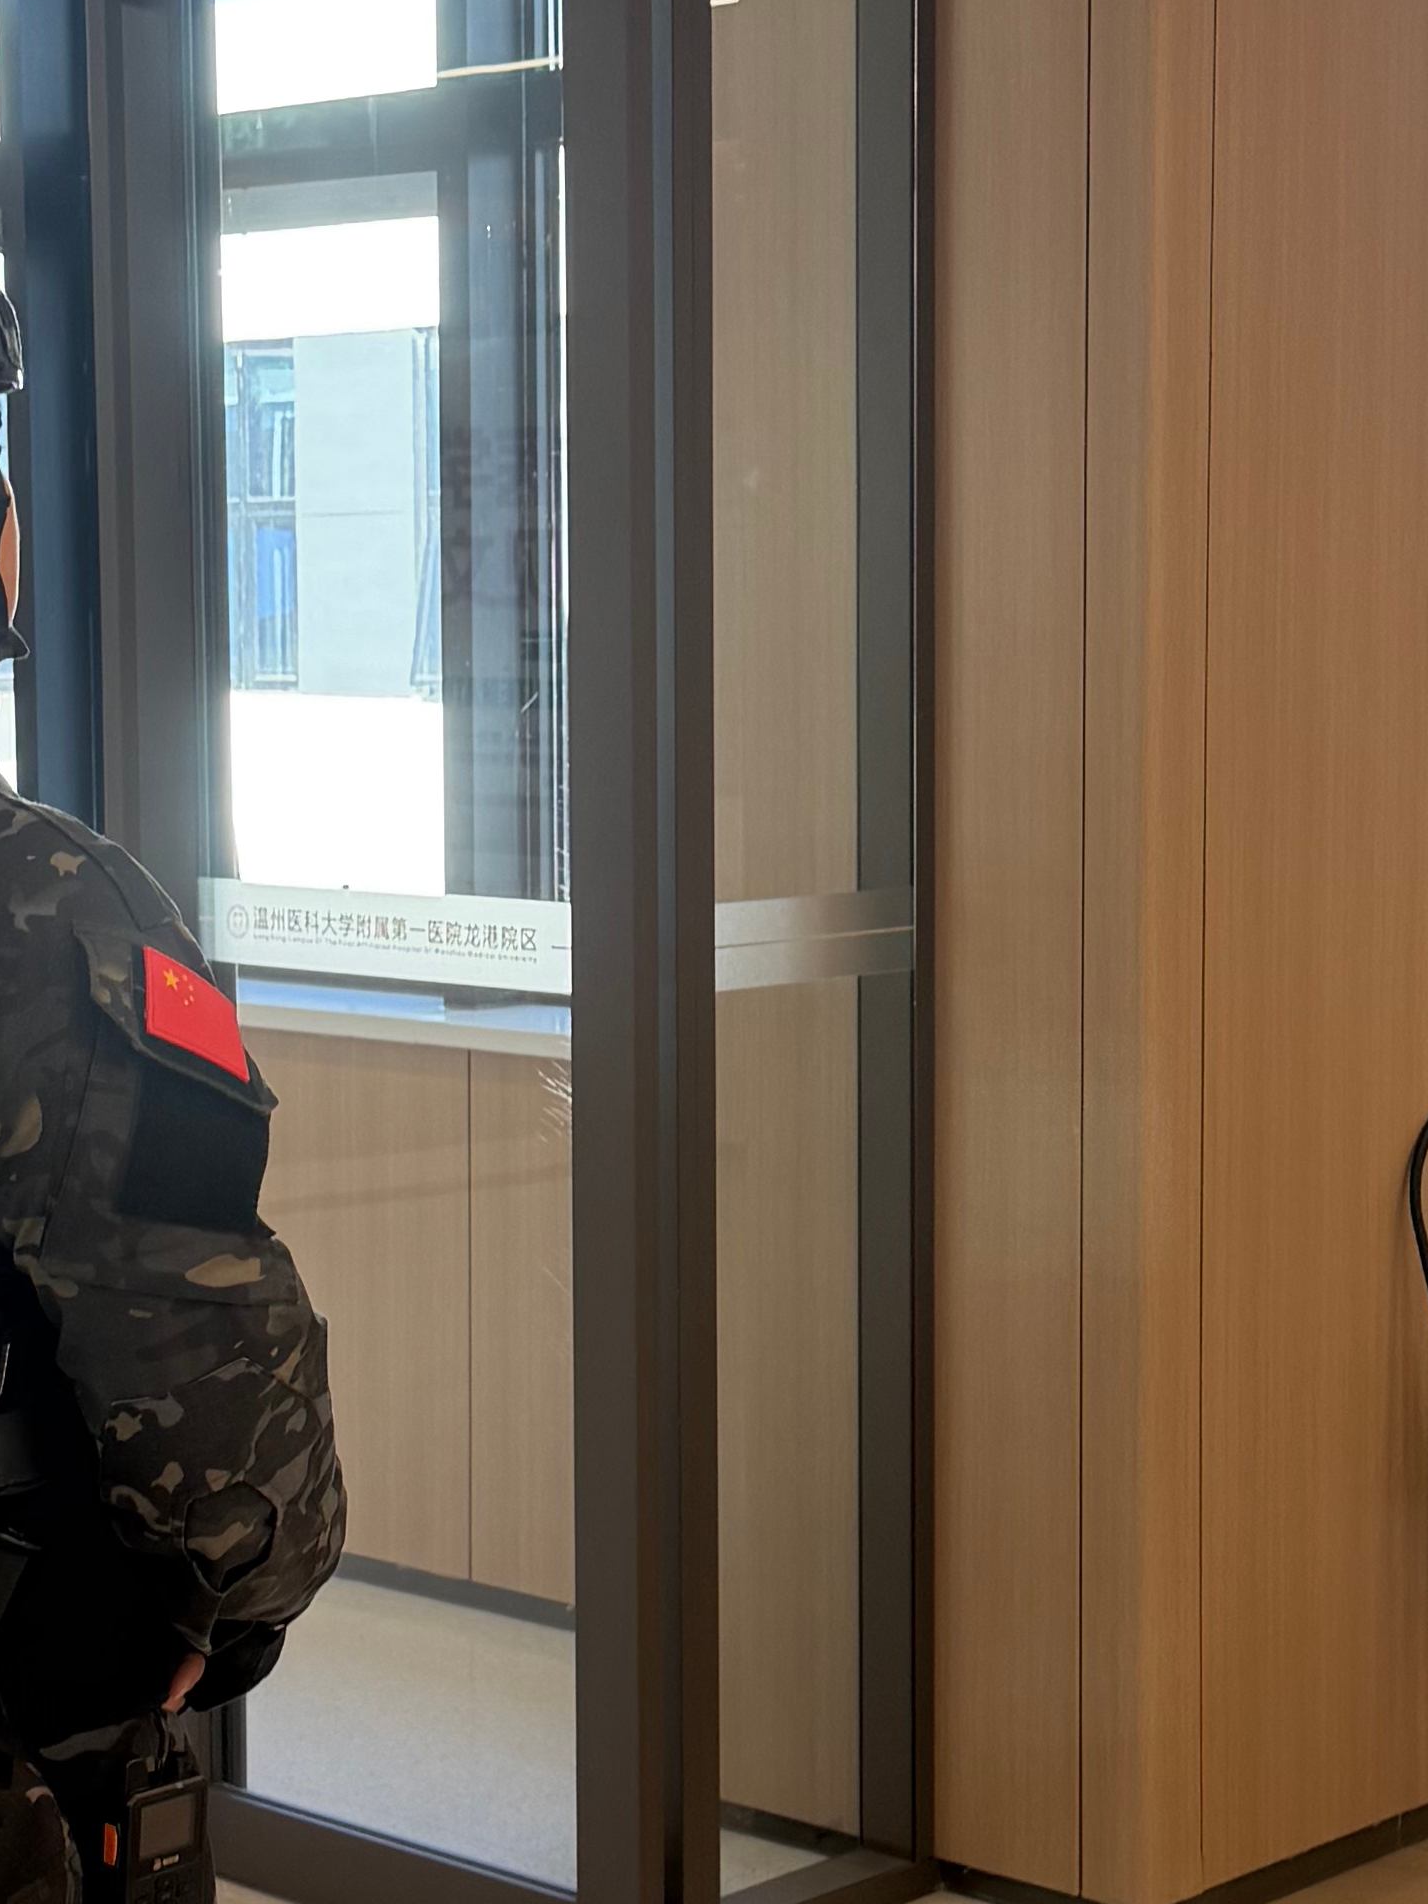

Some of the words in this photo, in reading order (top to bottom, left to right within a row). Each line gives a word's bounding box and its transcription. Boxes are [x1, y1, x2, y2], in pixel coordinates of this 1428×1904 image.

[253, 905, 538, 952] 温州医科大学附属第一医院龙港院区
